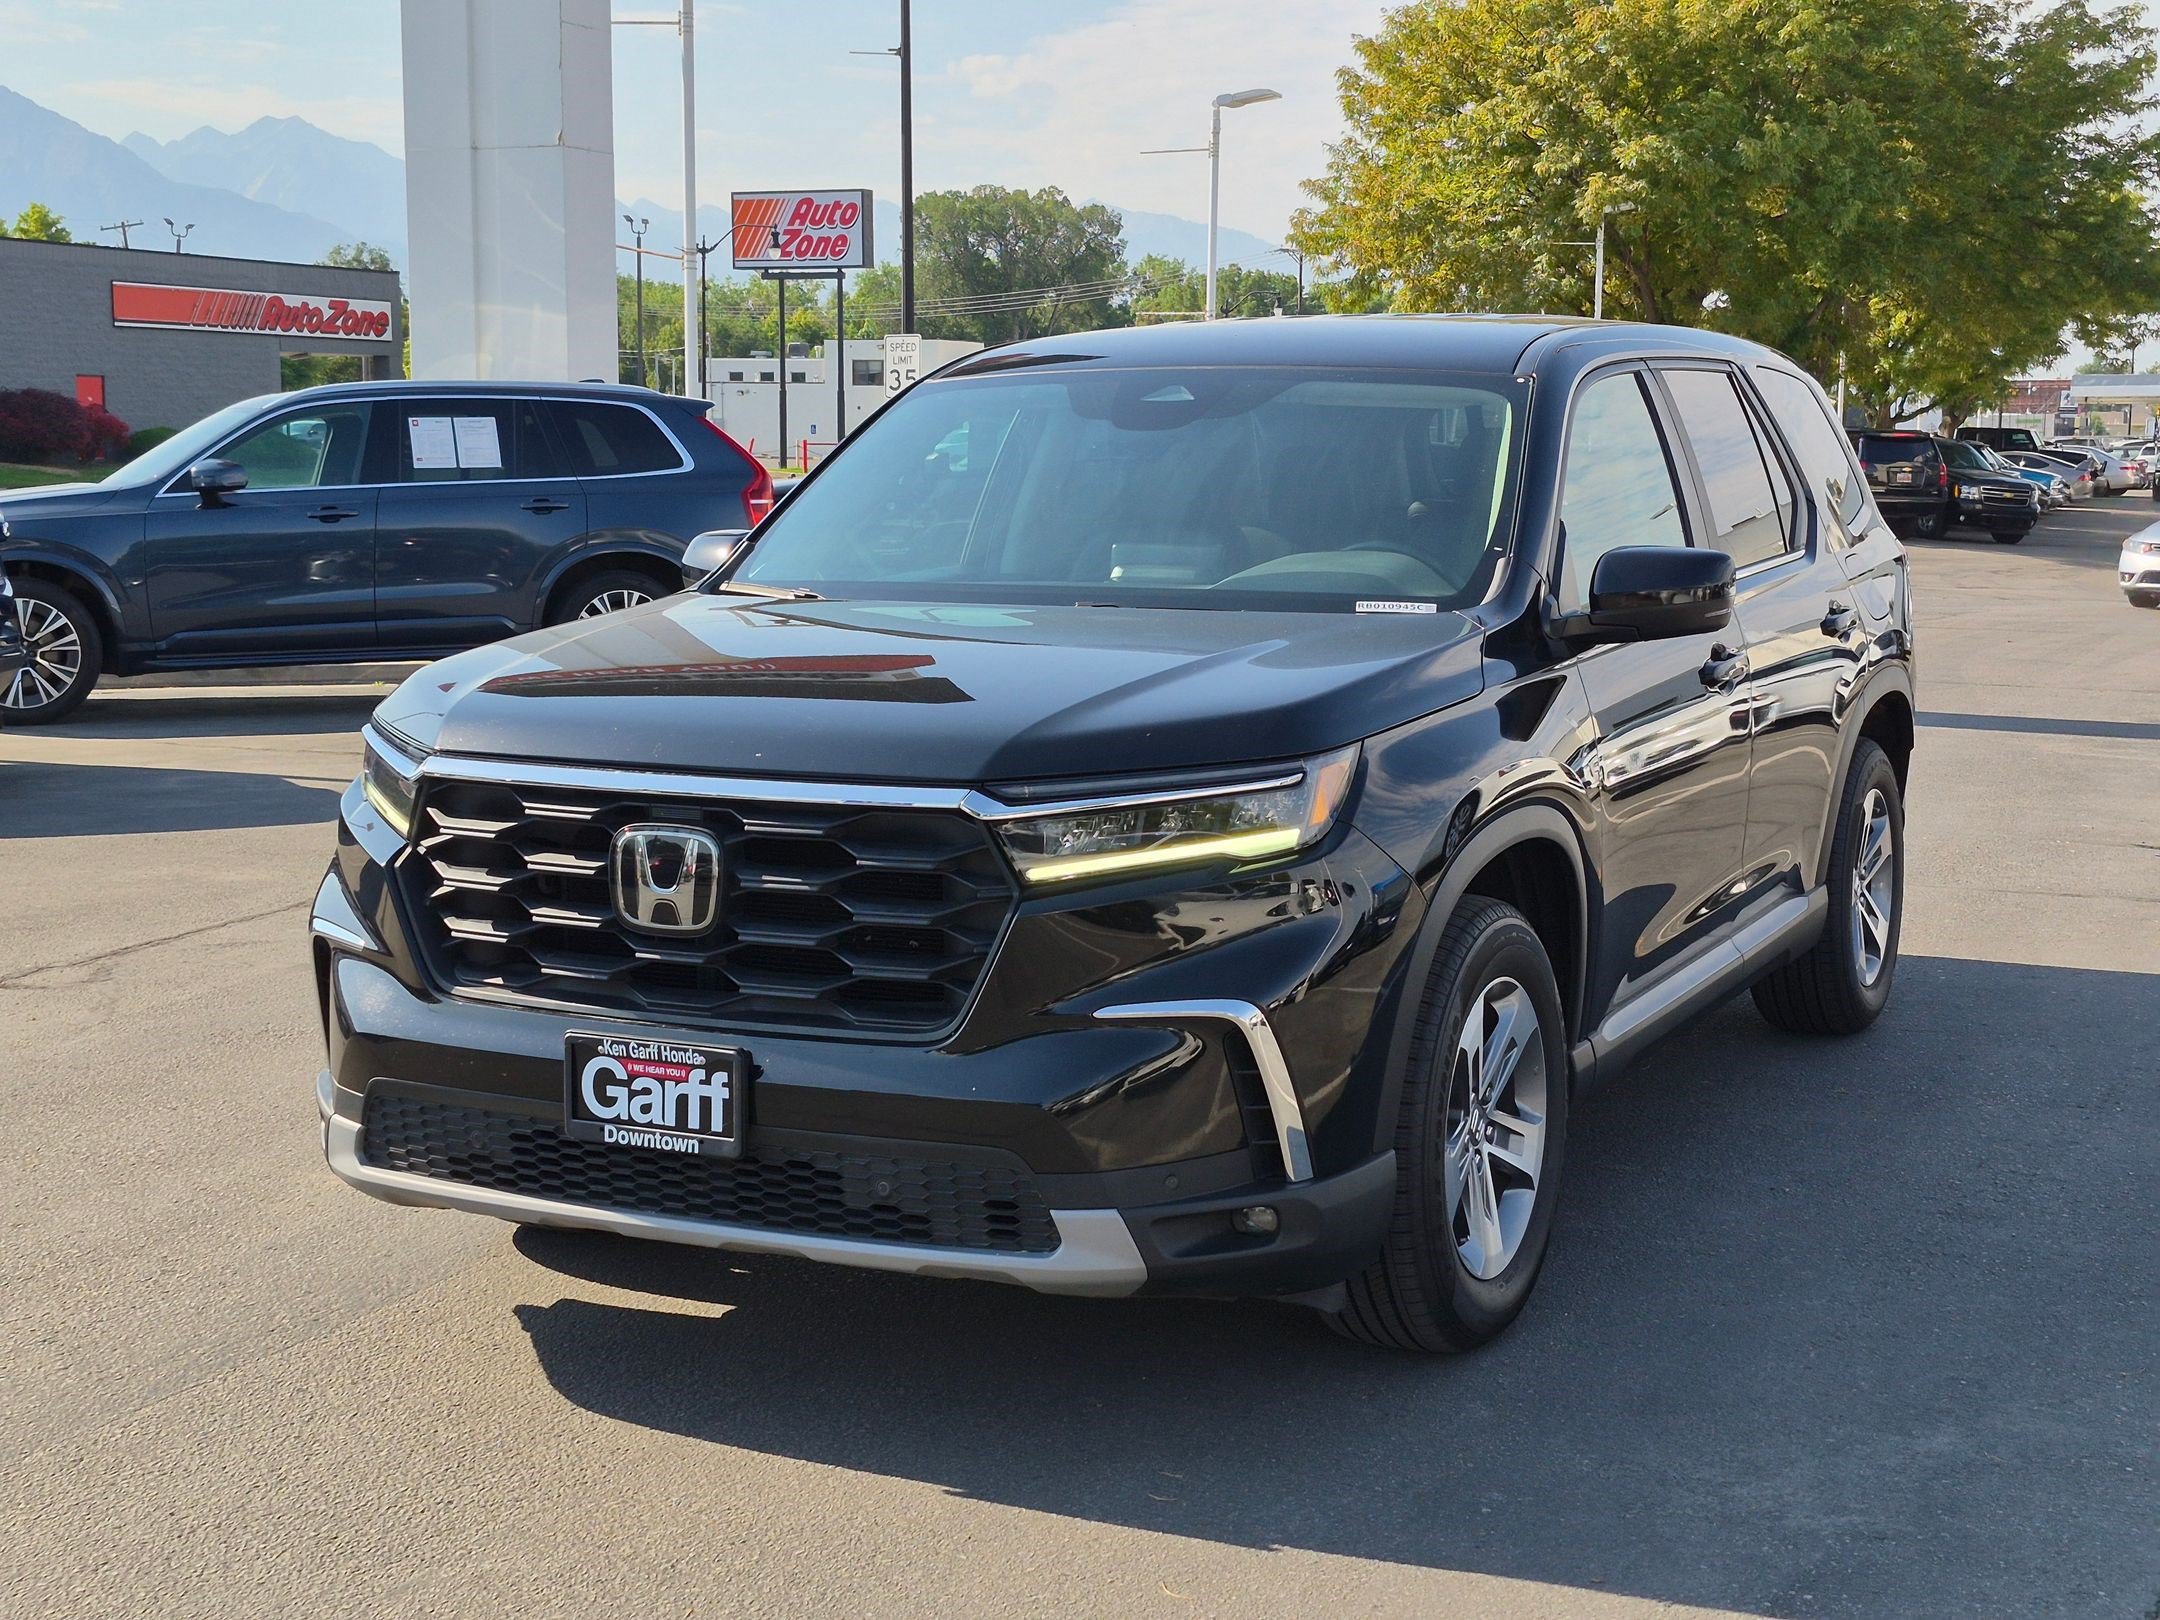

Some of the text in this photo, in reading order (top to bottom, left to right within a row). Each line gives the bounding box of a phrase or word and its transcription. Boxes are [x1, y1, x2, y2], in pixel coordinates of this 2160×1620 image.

[788, 197, 859, 229] Auto
[780, 229, 850, 260] Zone
[257, 295, 390, 337] AutoZone
[890, 342, 917, 352] SPEED
[892, 355, 913, 365] LIMIT
[604, 1039, 700, 1065] Ken Garff Honda
[633, 1063, 681, 1077] WE HEAR YOU
[581, 1056, 730, 1133] Garff
[604, 1125, 699, 1154] Downtown
